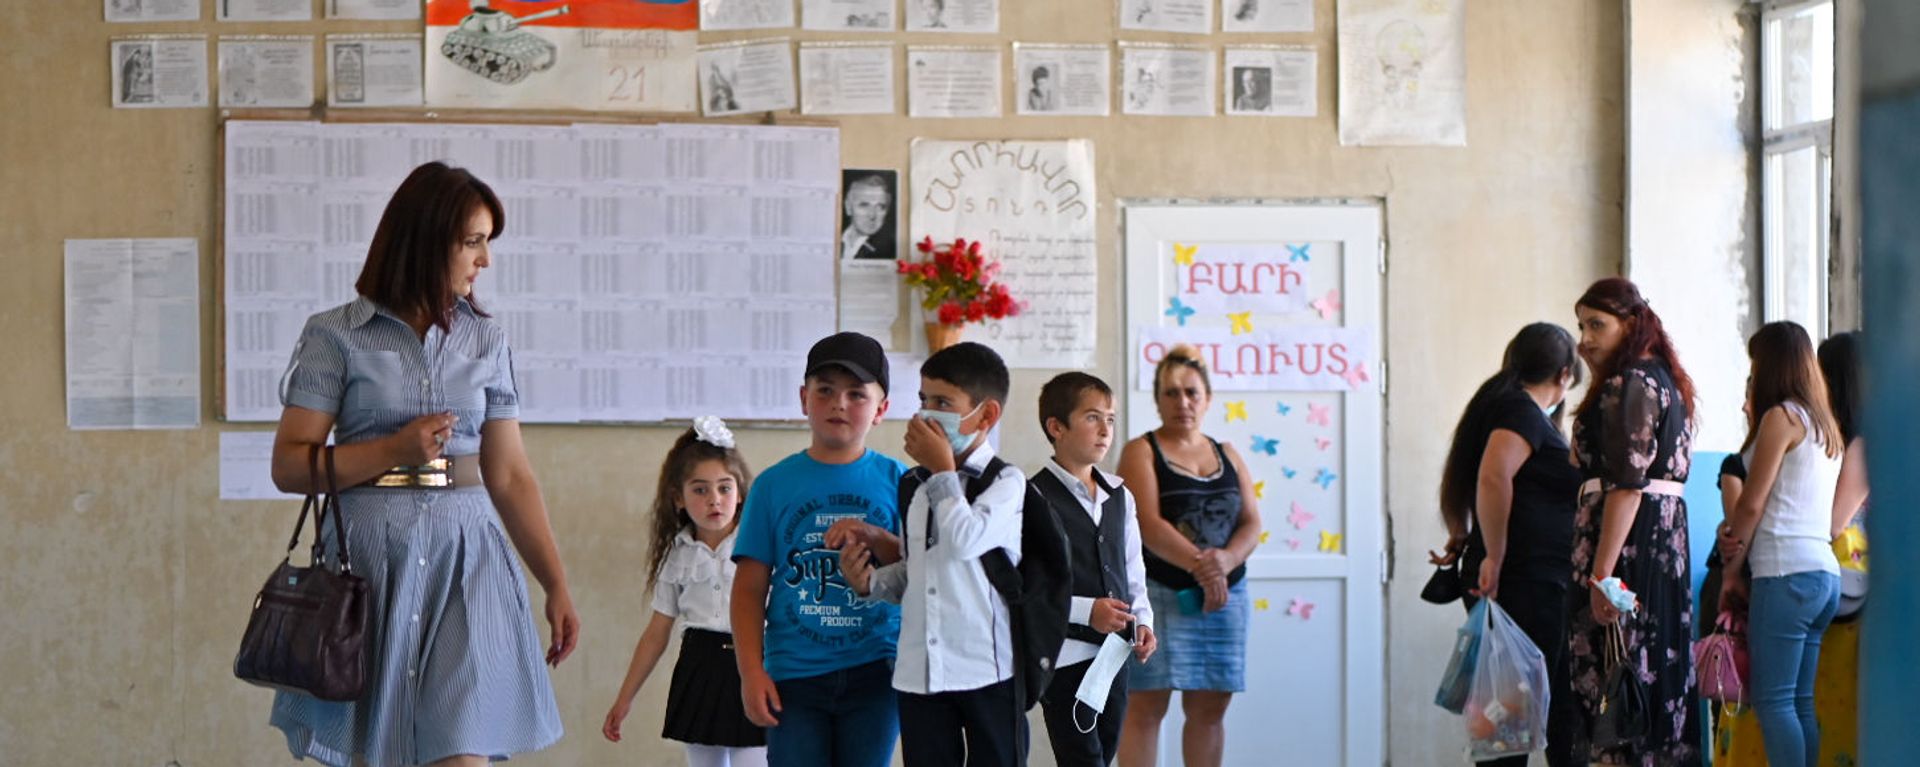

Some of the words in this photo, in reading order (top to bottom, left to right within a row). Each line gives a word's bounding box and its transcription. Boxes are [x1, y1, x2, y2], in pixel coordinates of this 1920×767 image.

[608, 66, 645, 101] 21
[1185, 262, 1301, 294] ԲԱՐԻ
[1143, 342, 1348, 377] ԳԼՈՒՍՏ
[828, 494, 870, 510] URBAN
[800, 605, 840, 615] PREMIUM
[820, 616, 862, 627] PRODUCT
